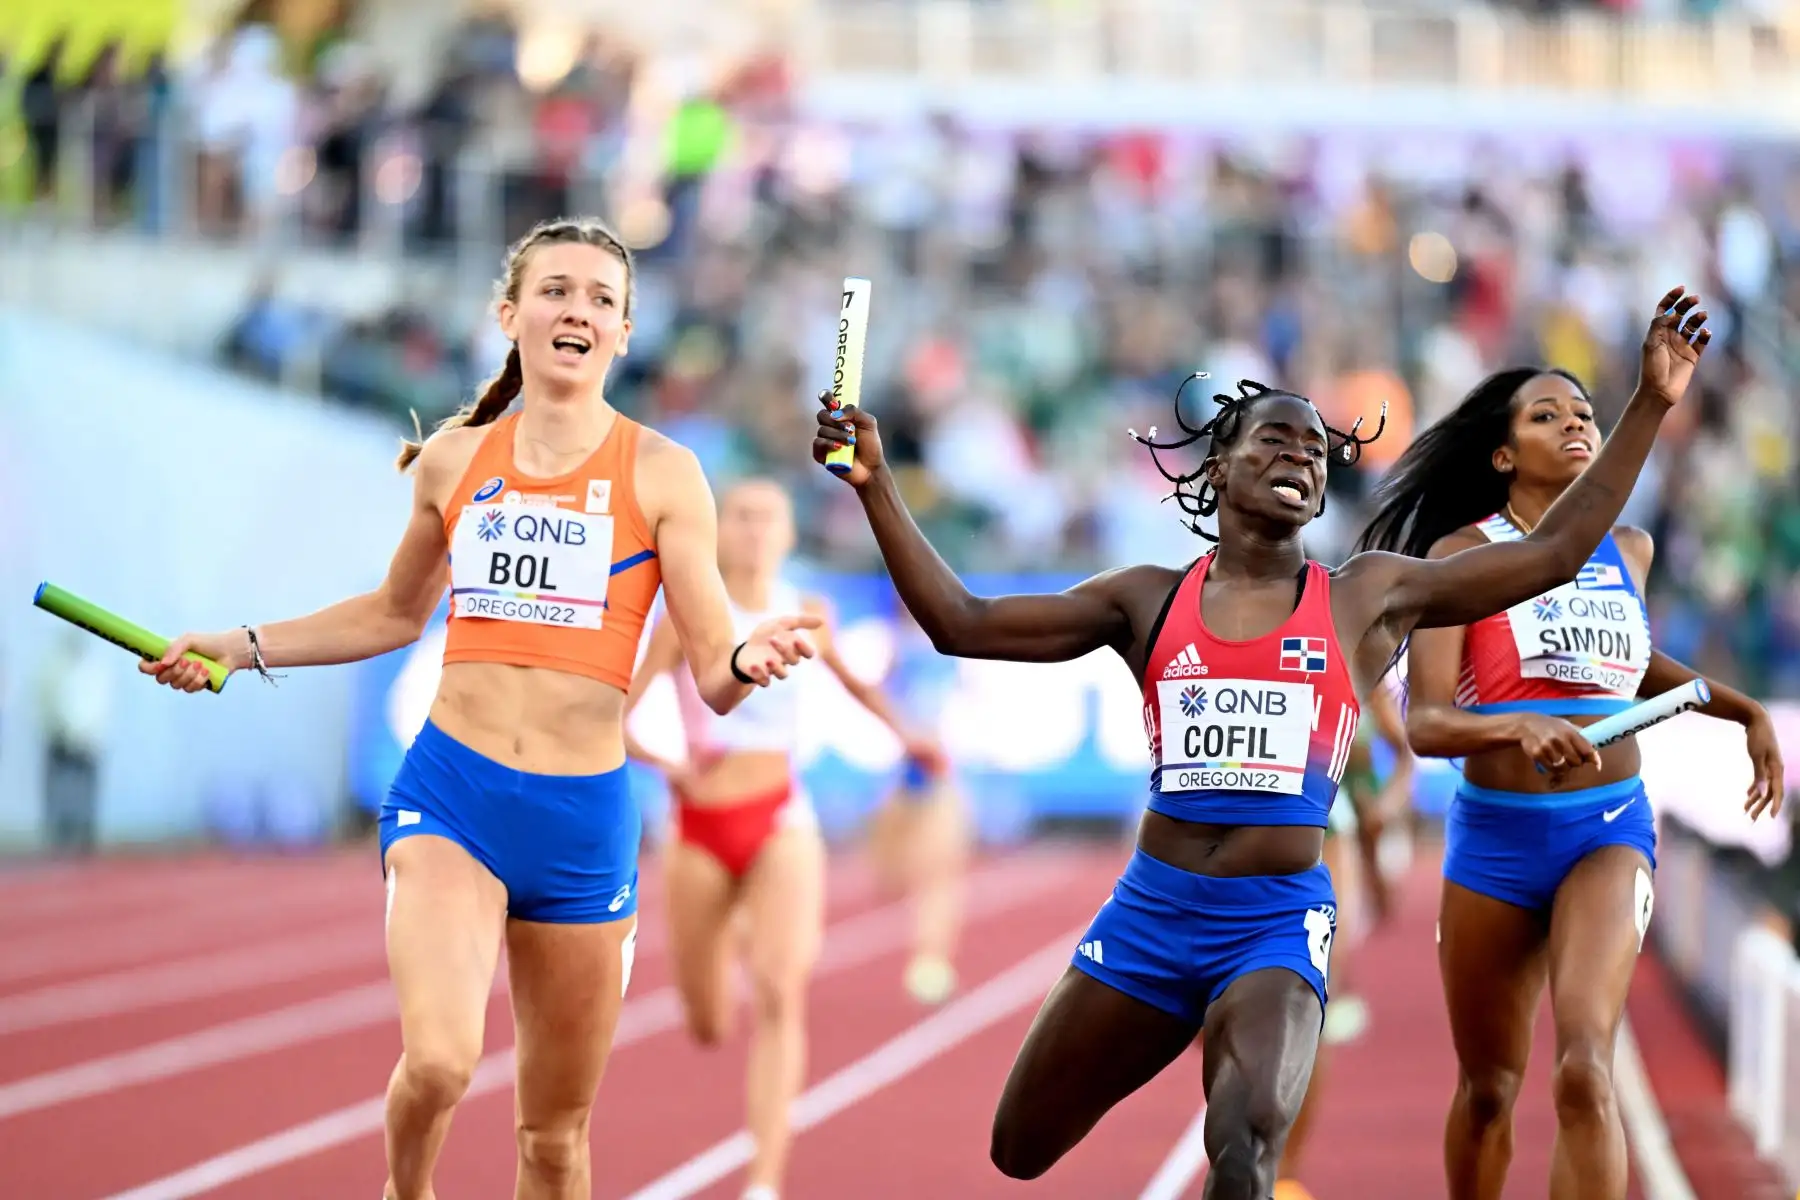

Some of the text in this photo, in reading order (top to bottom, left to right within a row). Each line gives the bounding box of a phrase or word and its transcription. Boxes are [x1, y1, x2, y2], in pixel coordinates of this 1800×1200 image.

[514, 515, 586, 546] QNB
[488, 551, 557, 591] BOL
[466, 597, 576, 623] OREGON22
[1568, 597, 1627, 622] QNB
[1539, 626, 1631, 661] SIMON
[1163, 664, 1209, 679] adidas
[1545, 663, 1625, 688] OREGN22
[1214, 688, 1287, 716] QNB
[1184, 724, 1277, 760] COFIL
[1178, 771, 1280, 789] OREGON22
